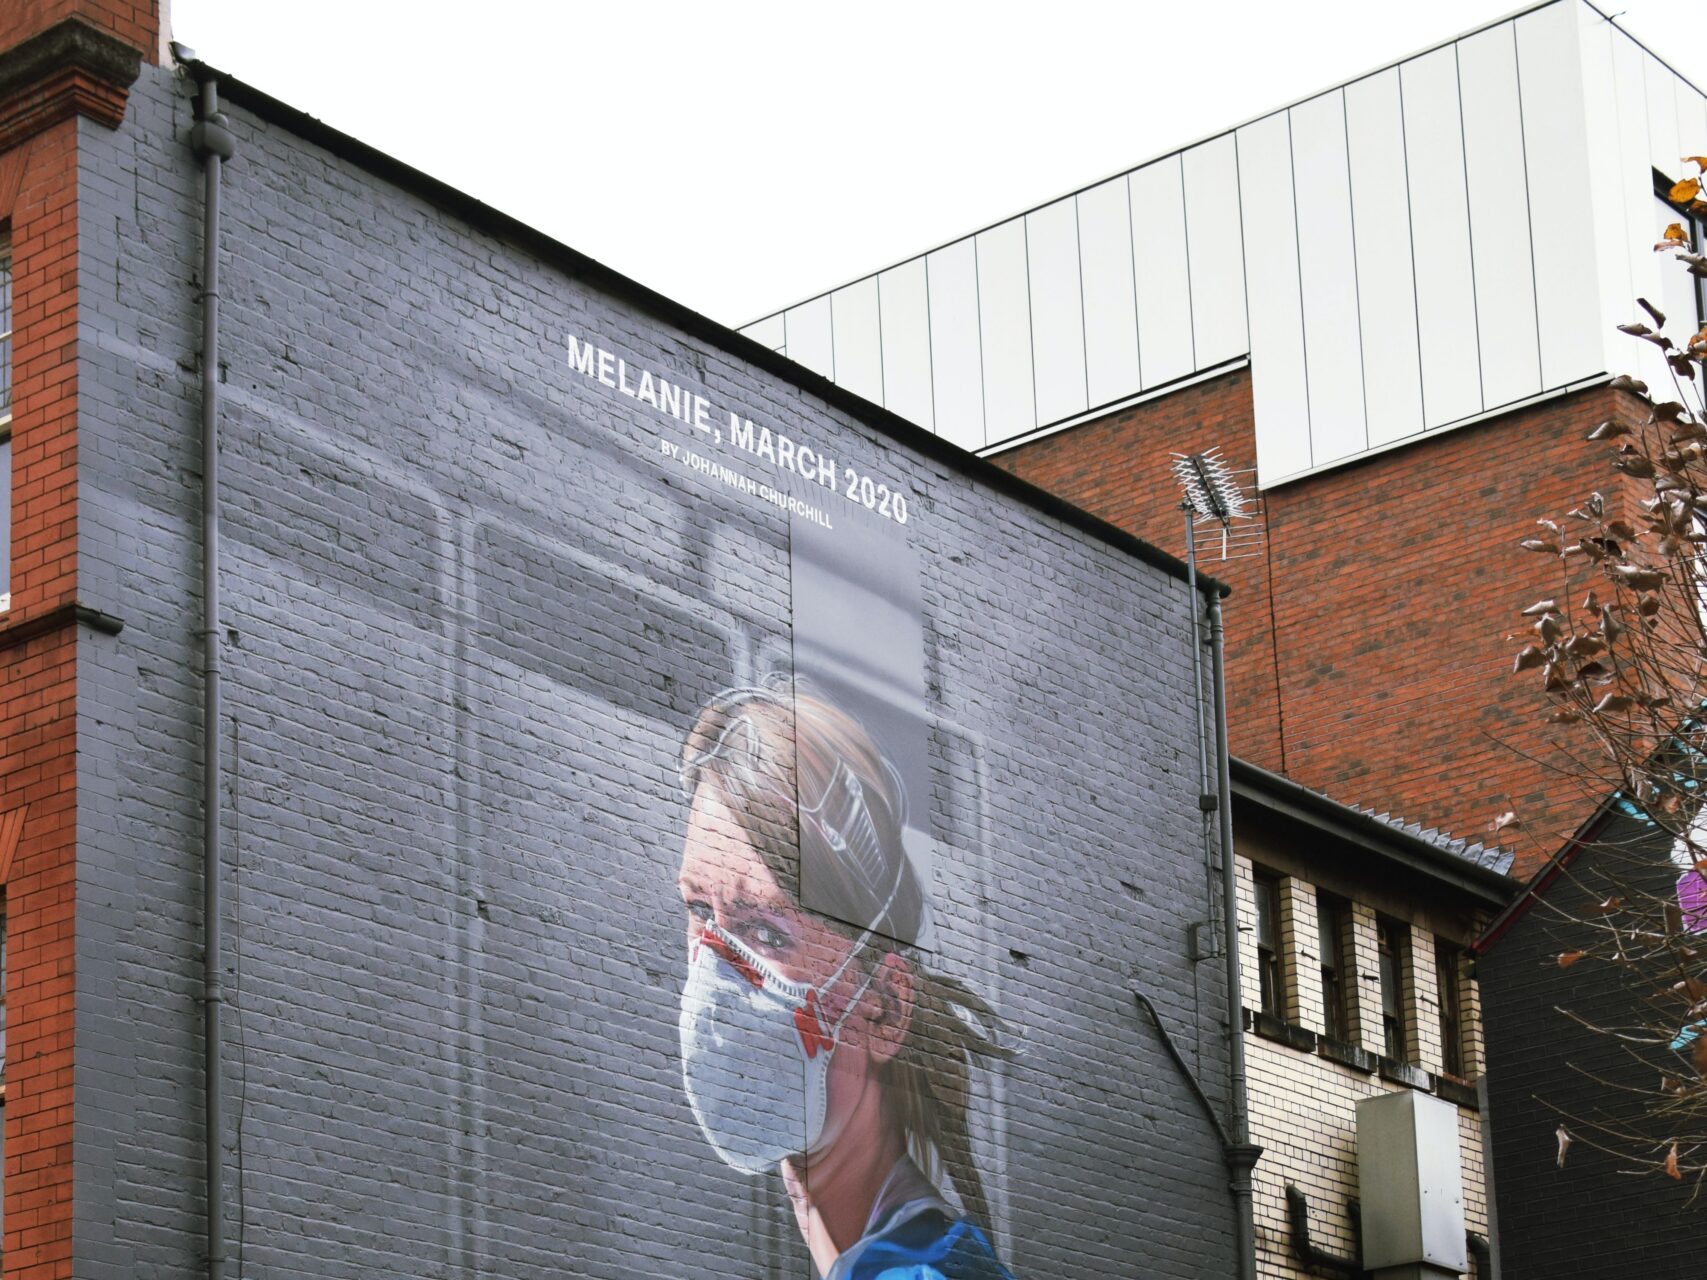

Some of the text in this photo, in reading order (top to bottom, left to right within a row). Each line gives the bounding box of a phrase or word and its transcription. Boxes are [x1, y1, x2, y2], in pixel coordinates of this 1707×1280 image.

[568, 335, 908, 524] MELANIE, MARCH 2020
[660, 439, 833, 529] BY JOHANNAH CHURCHILL
